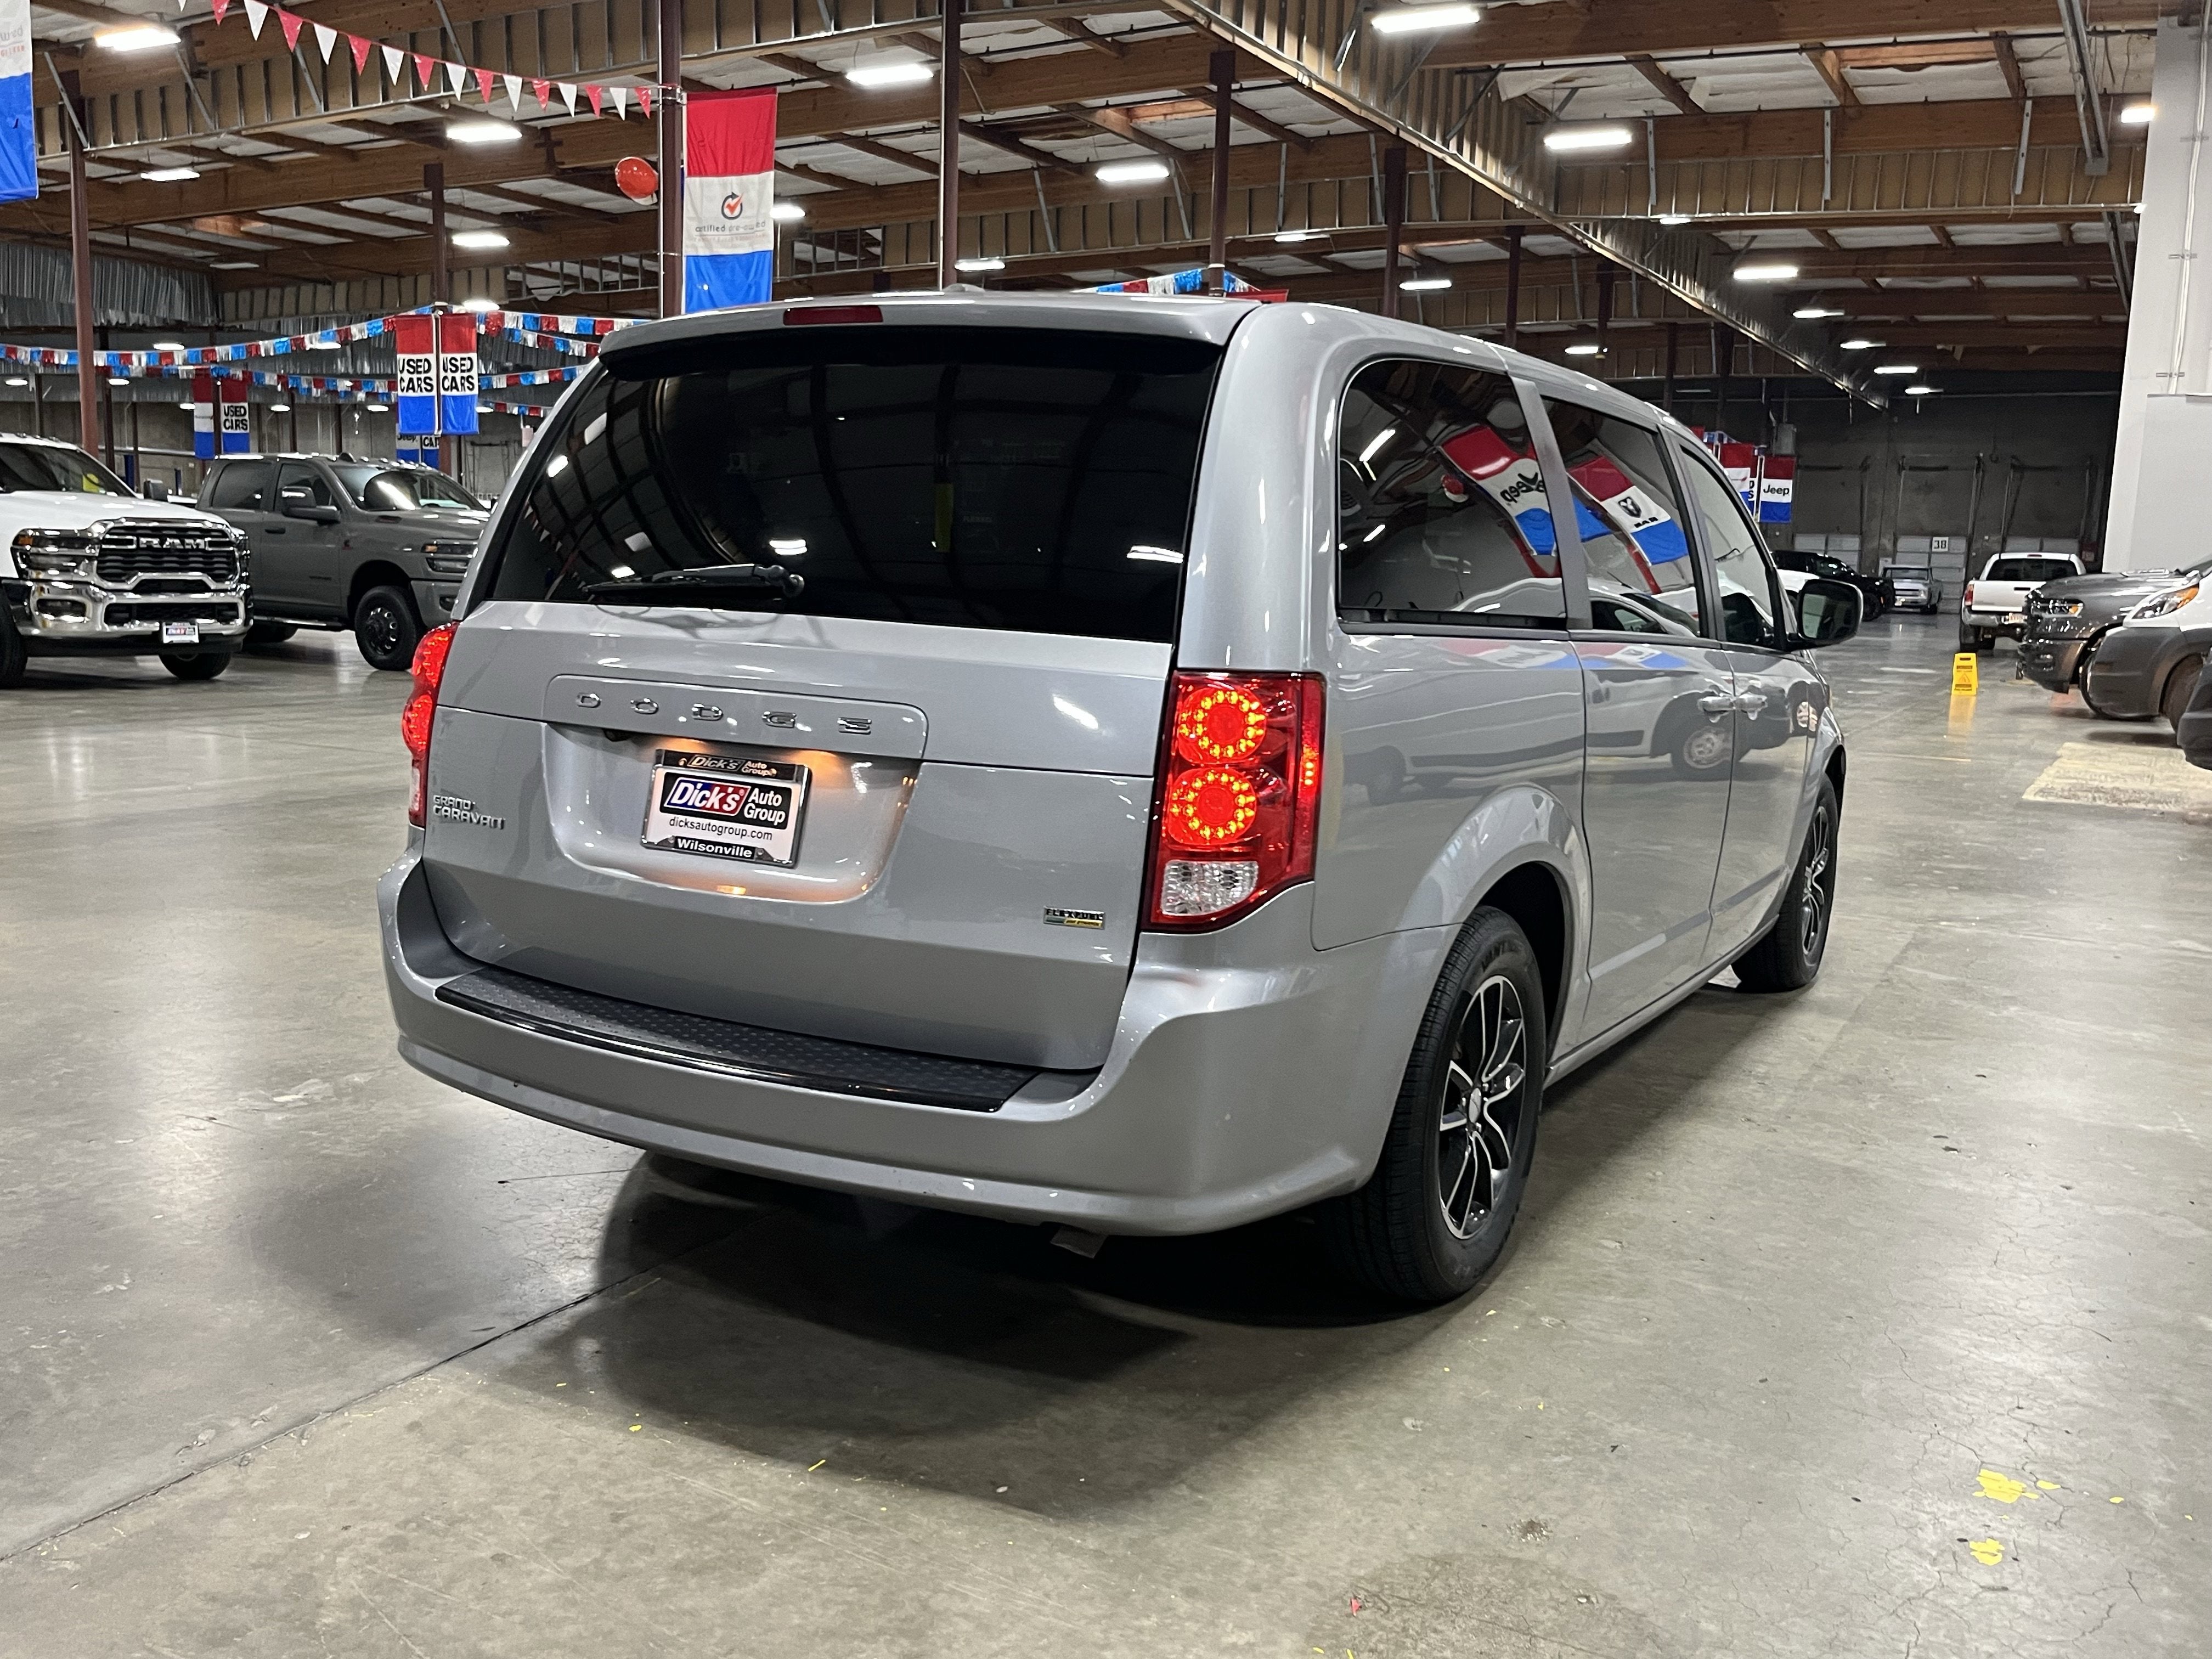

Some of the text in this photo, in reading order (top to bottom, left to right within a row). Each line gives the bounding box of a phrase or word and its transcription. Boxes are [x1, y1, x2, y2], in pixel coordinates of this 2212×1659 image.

[695, 224, 726, 233] cetified
[399, 358, 432, 374] USED
[442, 357, 473, 373] USED
[399, 376, 434, 393] CARS
[442, 375, 475, 392] CARS
[223, 405, 247, 417] USED
[223, 419, 247, 431] CARS
[1763, 484, 1790, 496] Jeep
[139, 537, 205, 549] RAM
[577, 692, 872, 735] DODGE
[691, 757, 767, 769] Dick's Auto
[742, 766, 772, 777] Group
[433, 795, 471, 810] GRAND
[670, 779, 782, 811] Dick's Auto
[433, 805, 503, 830] CARAVAN
[744, 806, 786, 826] Group
[669, 816, 773, 841] dicksautogroup.com
[677, 838, 753, 858] Wilsonville
